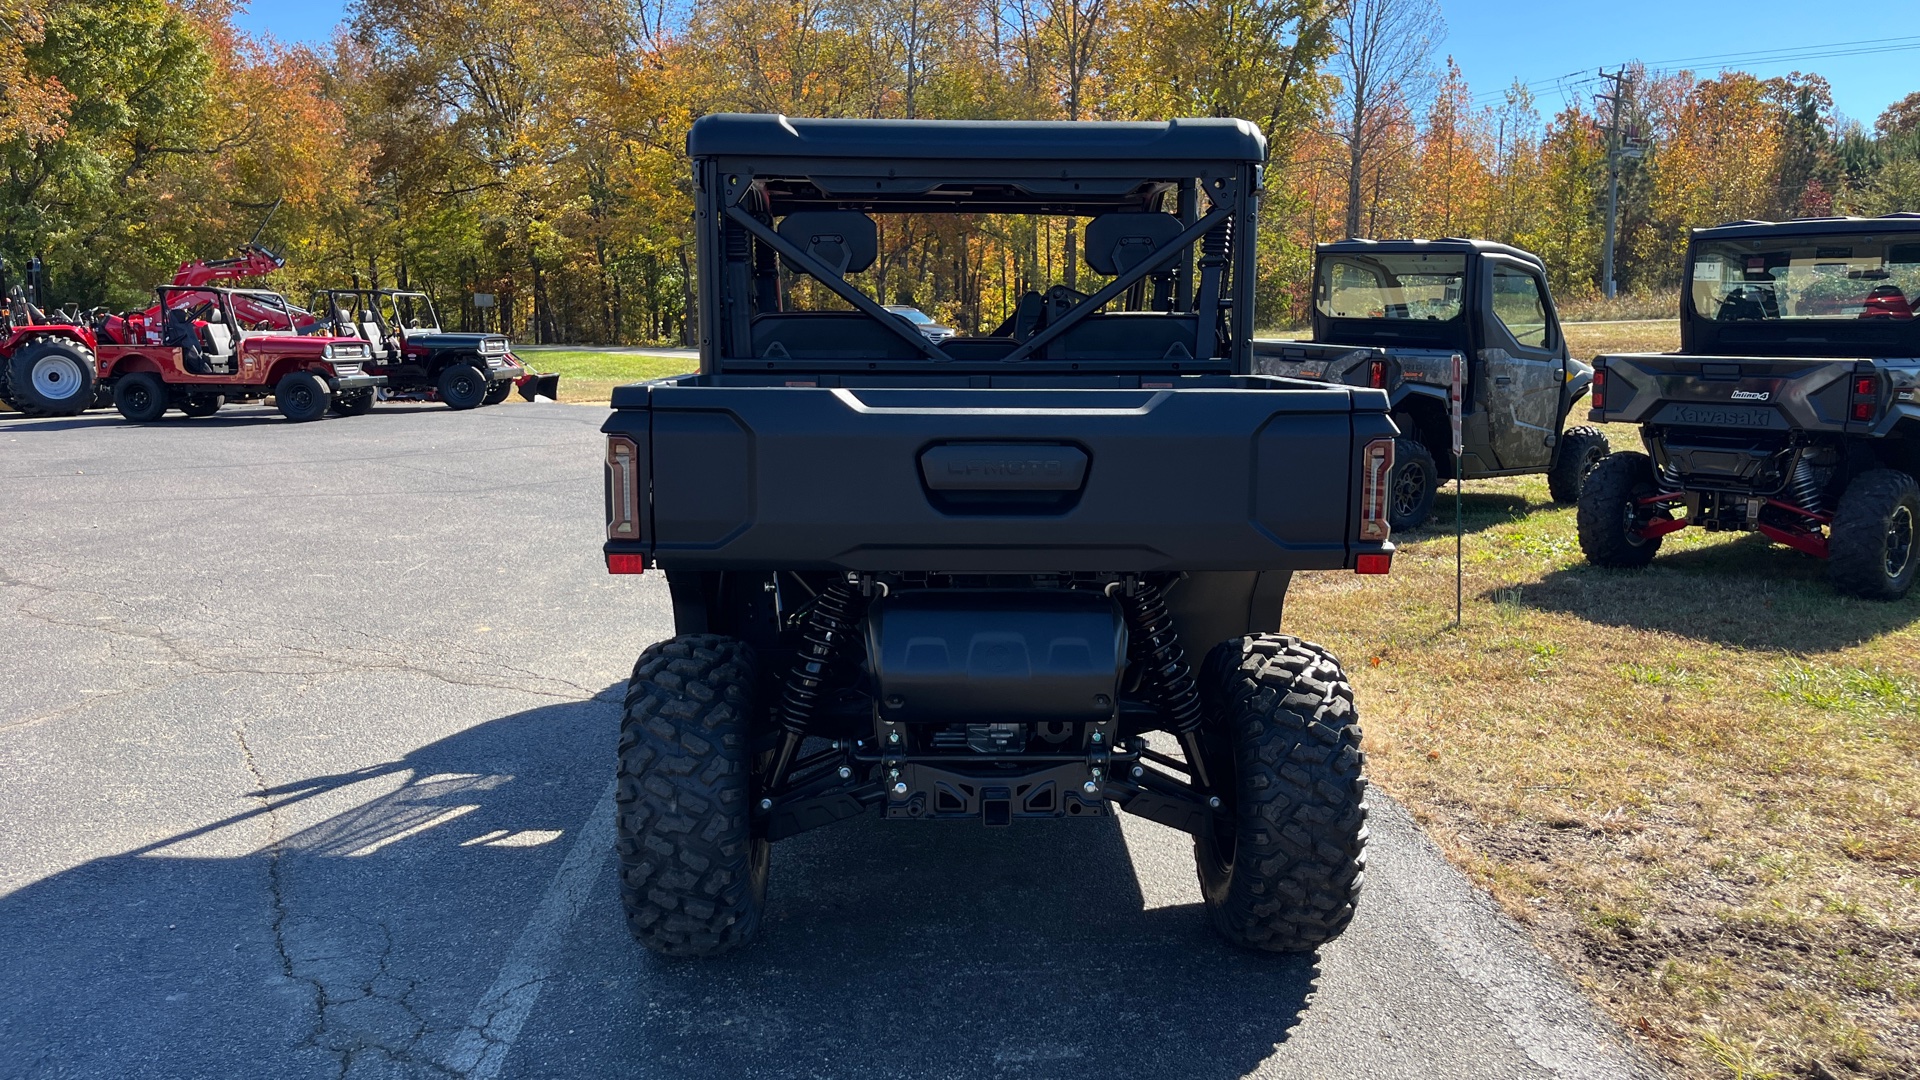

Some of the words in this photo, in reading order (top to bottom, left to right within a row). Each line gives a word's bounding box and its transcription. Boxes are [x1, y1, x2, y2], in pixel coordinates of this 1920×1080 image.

[1731, 390, 1759, 399] Inline
[1758, 392, 1769, 400] 4
[1674, 405, 1770, 426] Kawasaki
